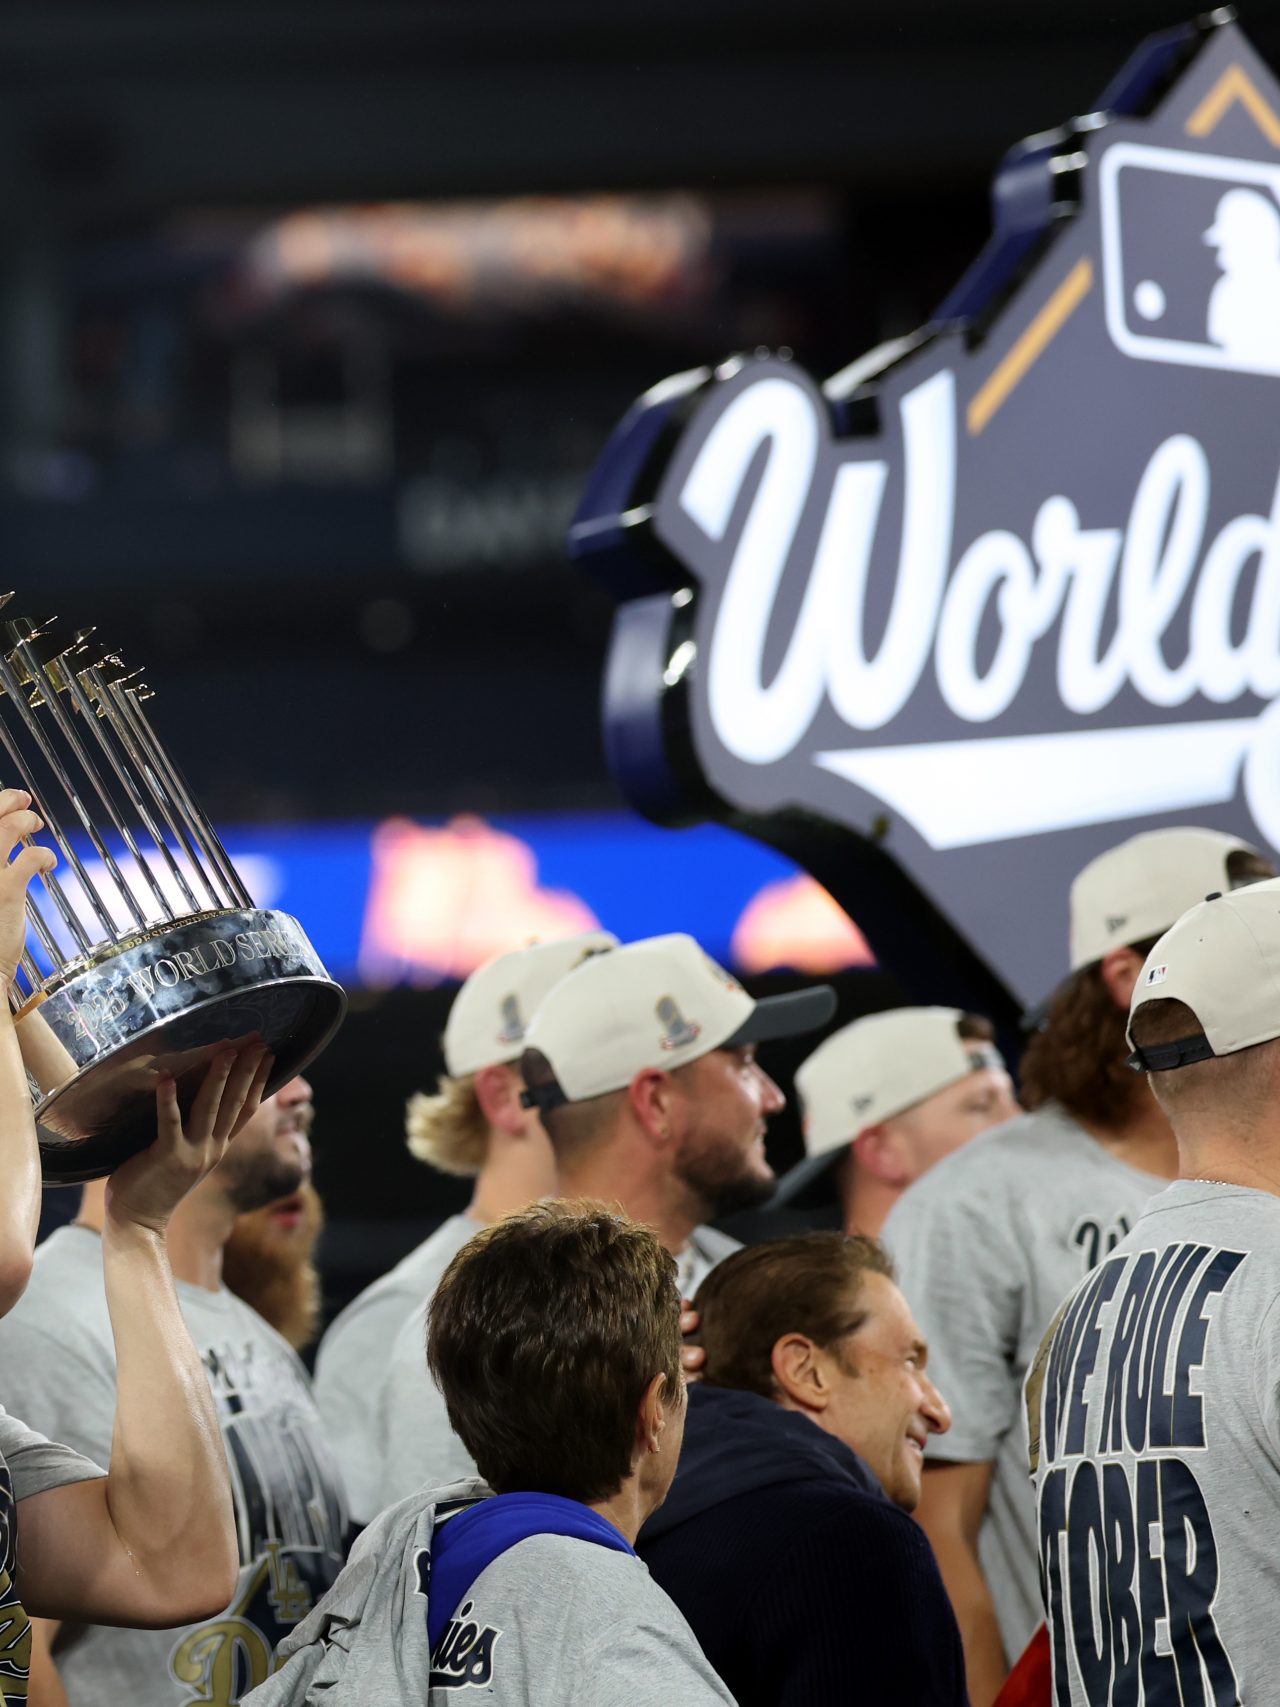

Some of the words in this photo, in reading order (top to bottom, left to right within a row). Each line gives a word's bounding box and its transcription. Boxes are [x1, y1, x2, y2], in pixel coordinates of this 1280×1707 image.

[679, 368, 1280, 765] World
[125, 938, 236, 998] WORLD
[1095, 1240, 1252, 1457] RULE
[1038, 1457, 1244, 1707] TOBER
